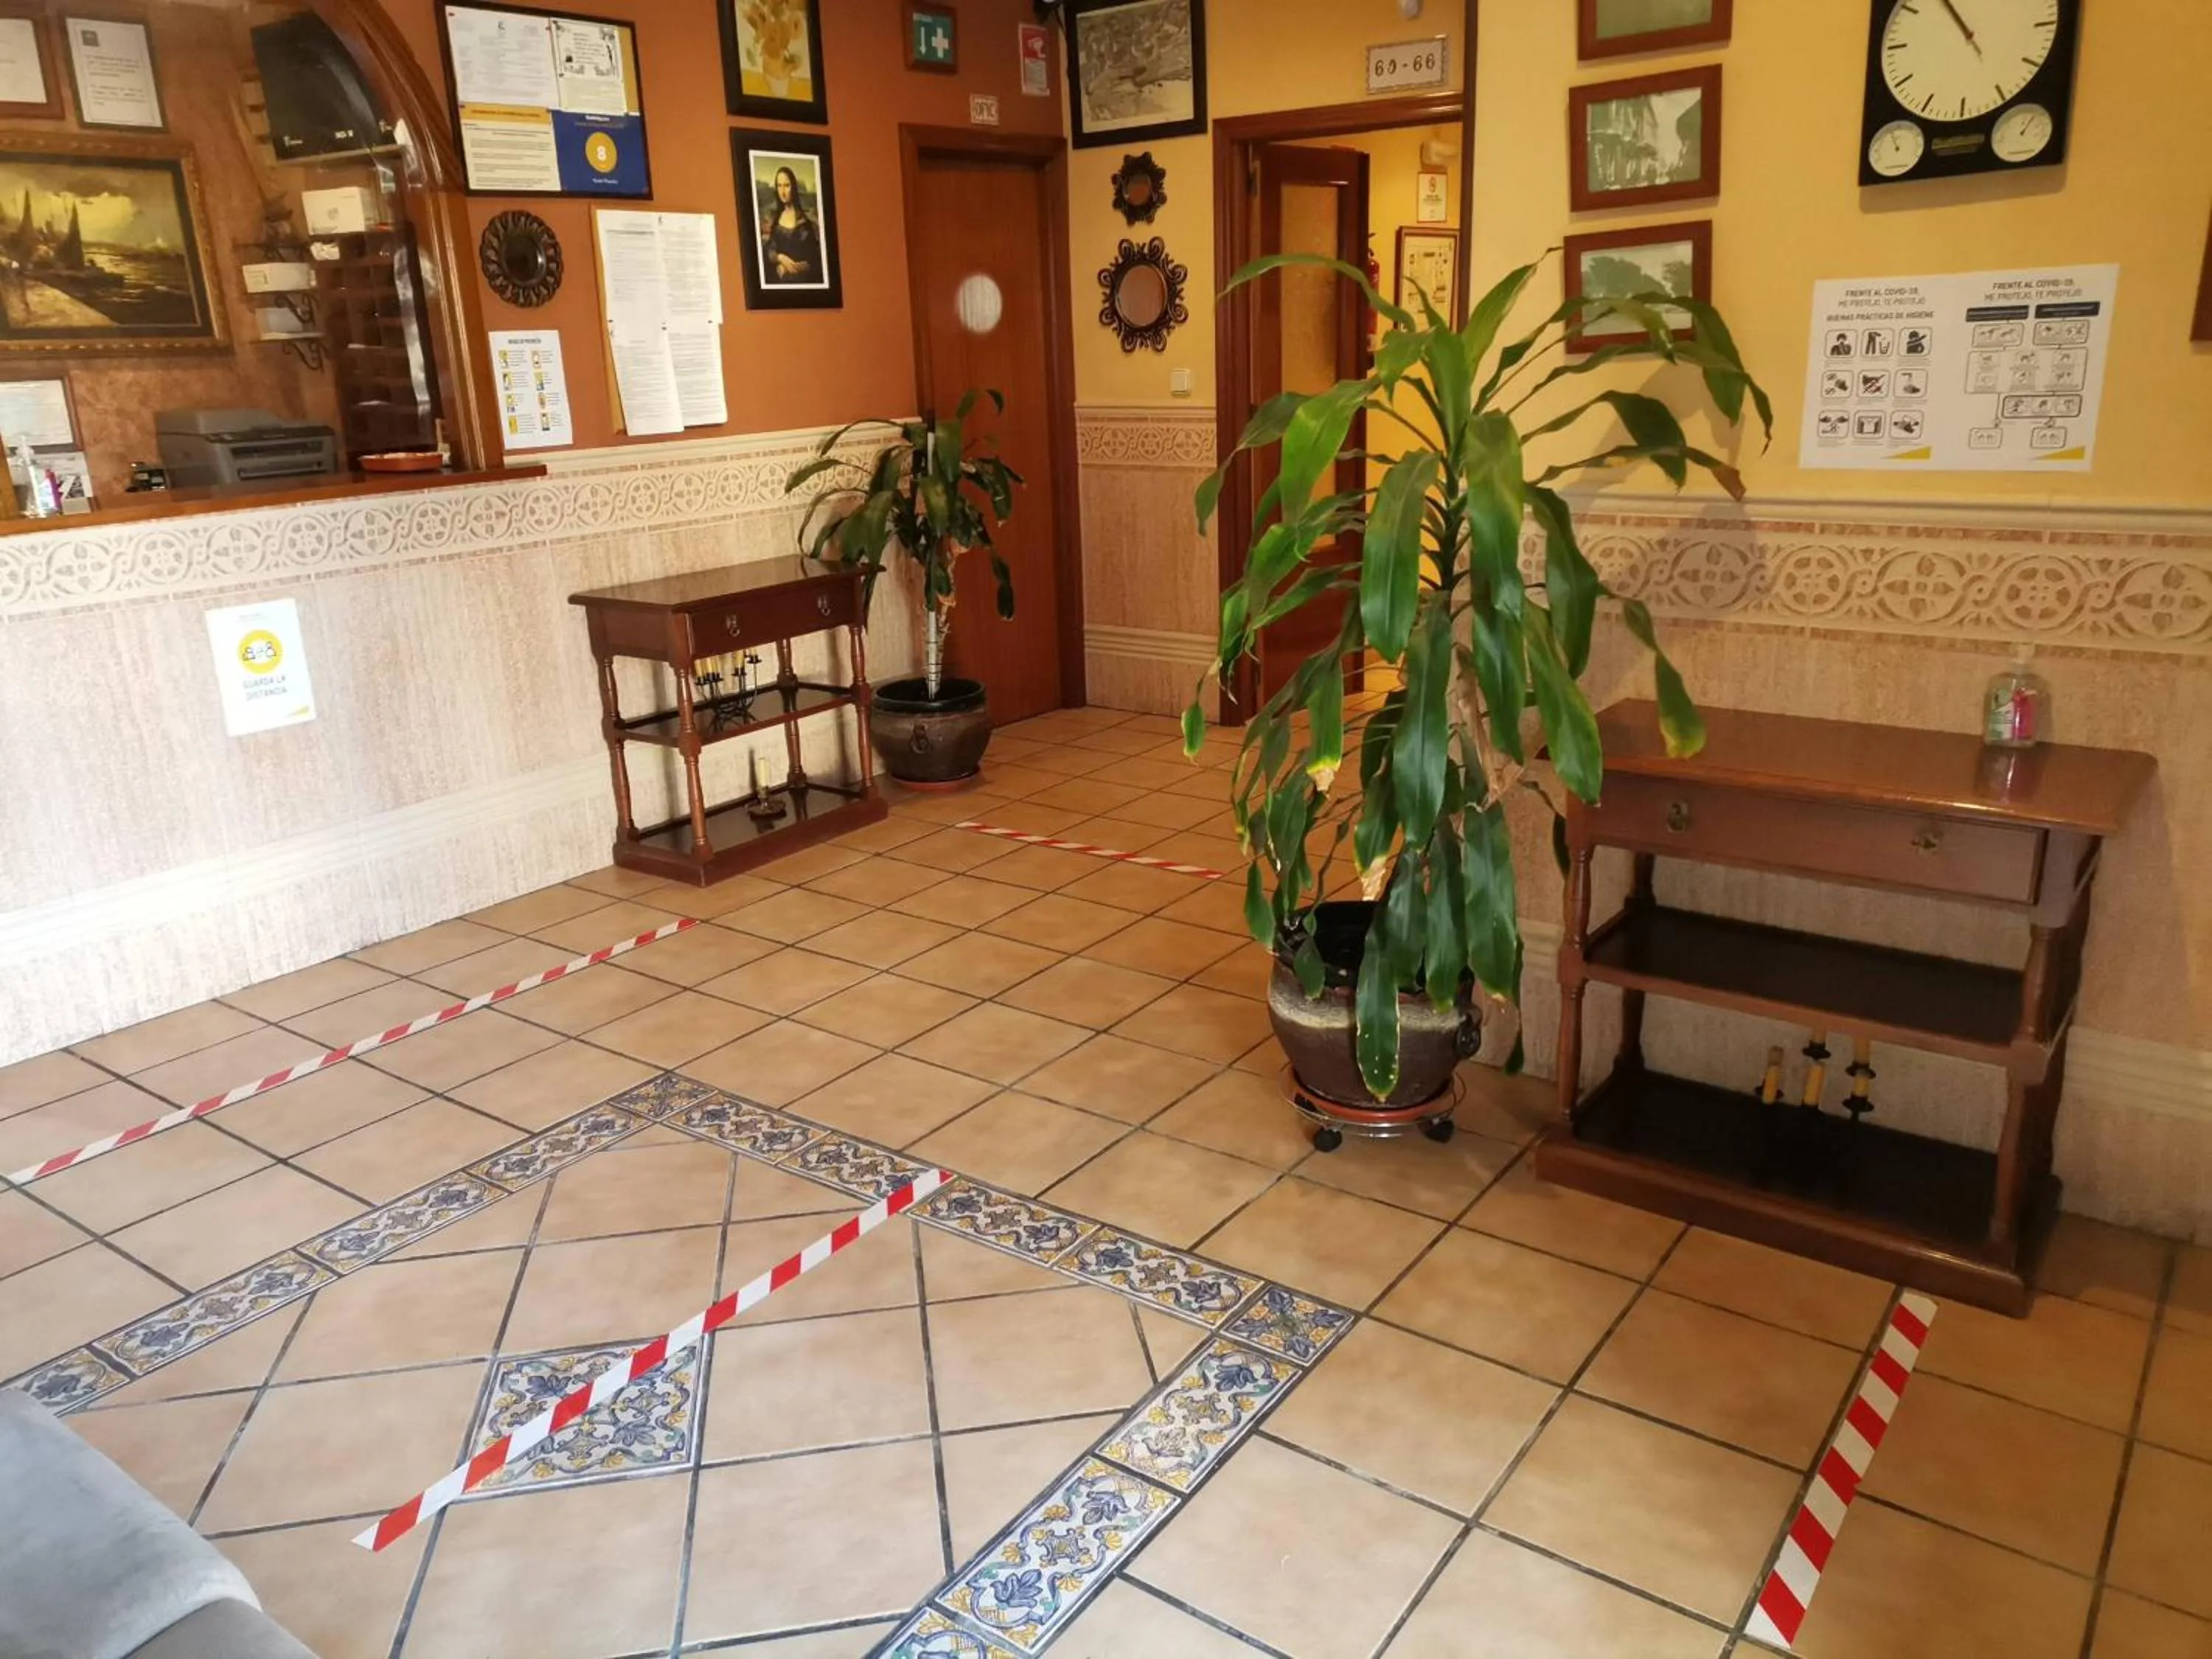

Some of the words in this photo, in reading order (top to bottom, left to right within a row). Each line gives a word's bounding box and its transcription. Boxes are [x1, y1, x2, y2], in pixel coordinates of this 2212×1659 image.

[1993, 282, 2023, 290] FRENTE
[1845, 289, 1873, 297] FRENTE
[1874, 288, 1882, 296] AL
